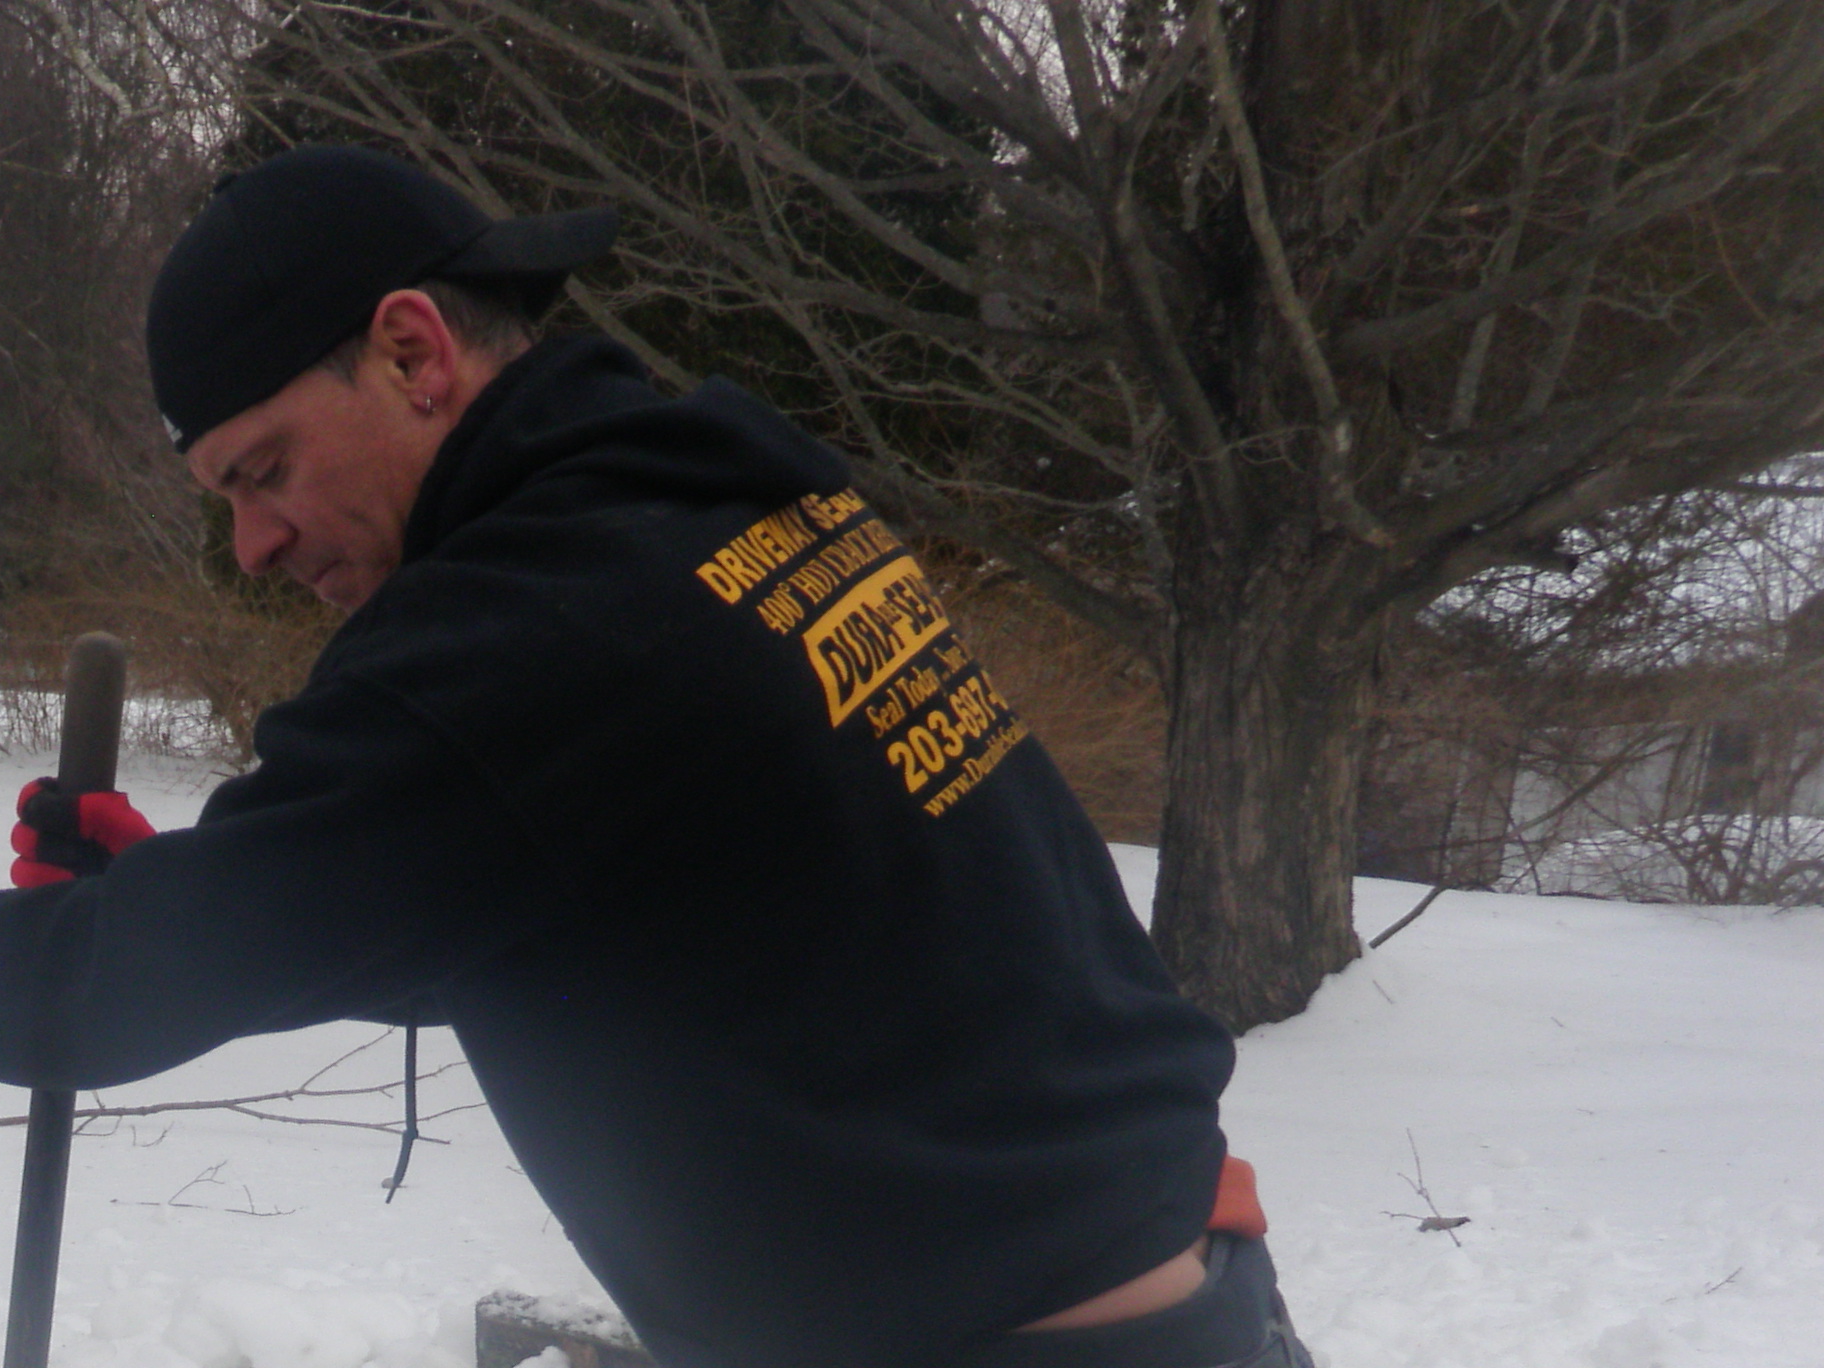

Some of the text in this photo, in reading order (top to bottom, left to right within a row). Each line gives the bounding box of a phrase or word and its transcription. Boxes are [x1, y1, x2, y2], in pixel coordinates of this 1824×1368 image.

[695, 503, 819, 605] DRIVEWAY
[788, 559, 840, 605] HOT
[866, 688, 908, 739] Seal
